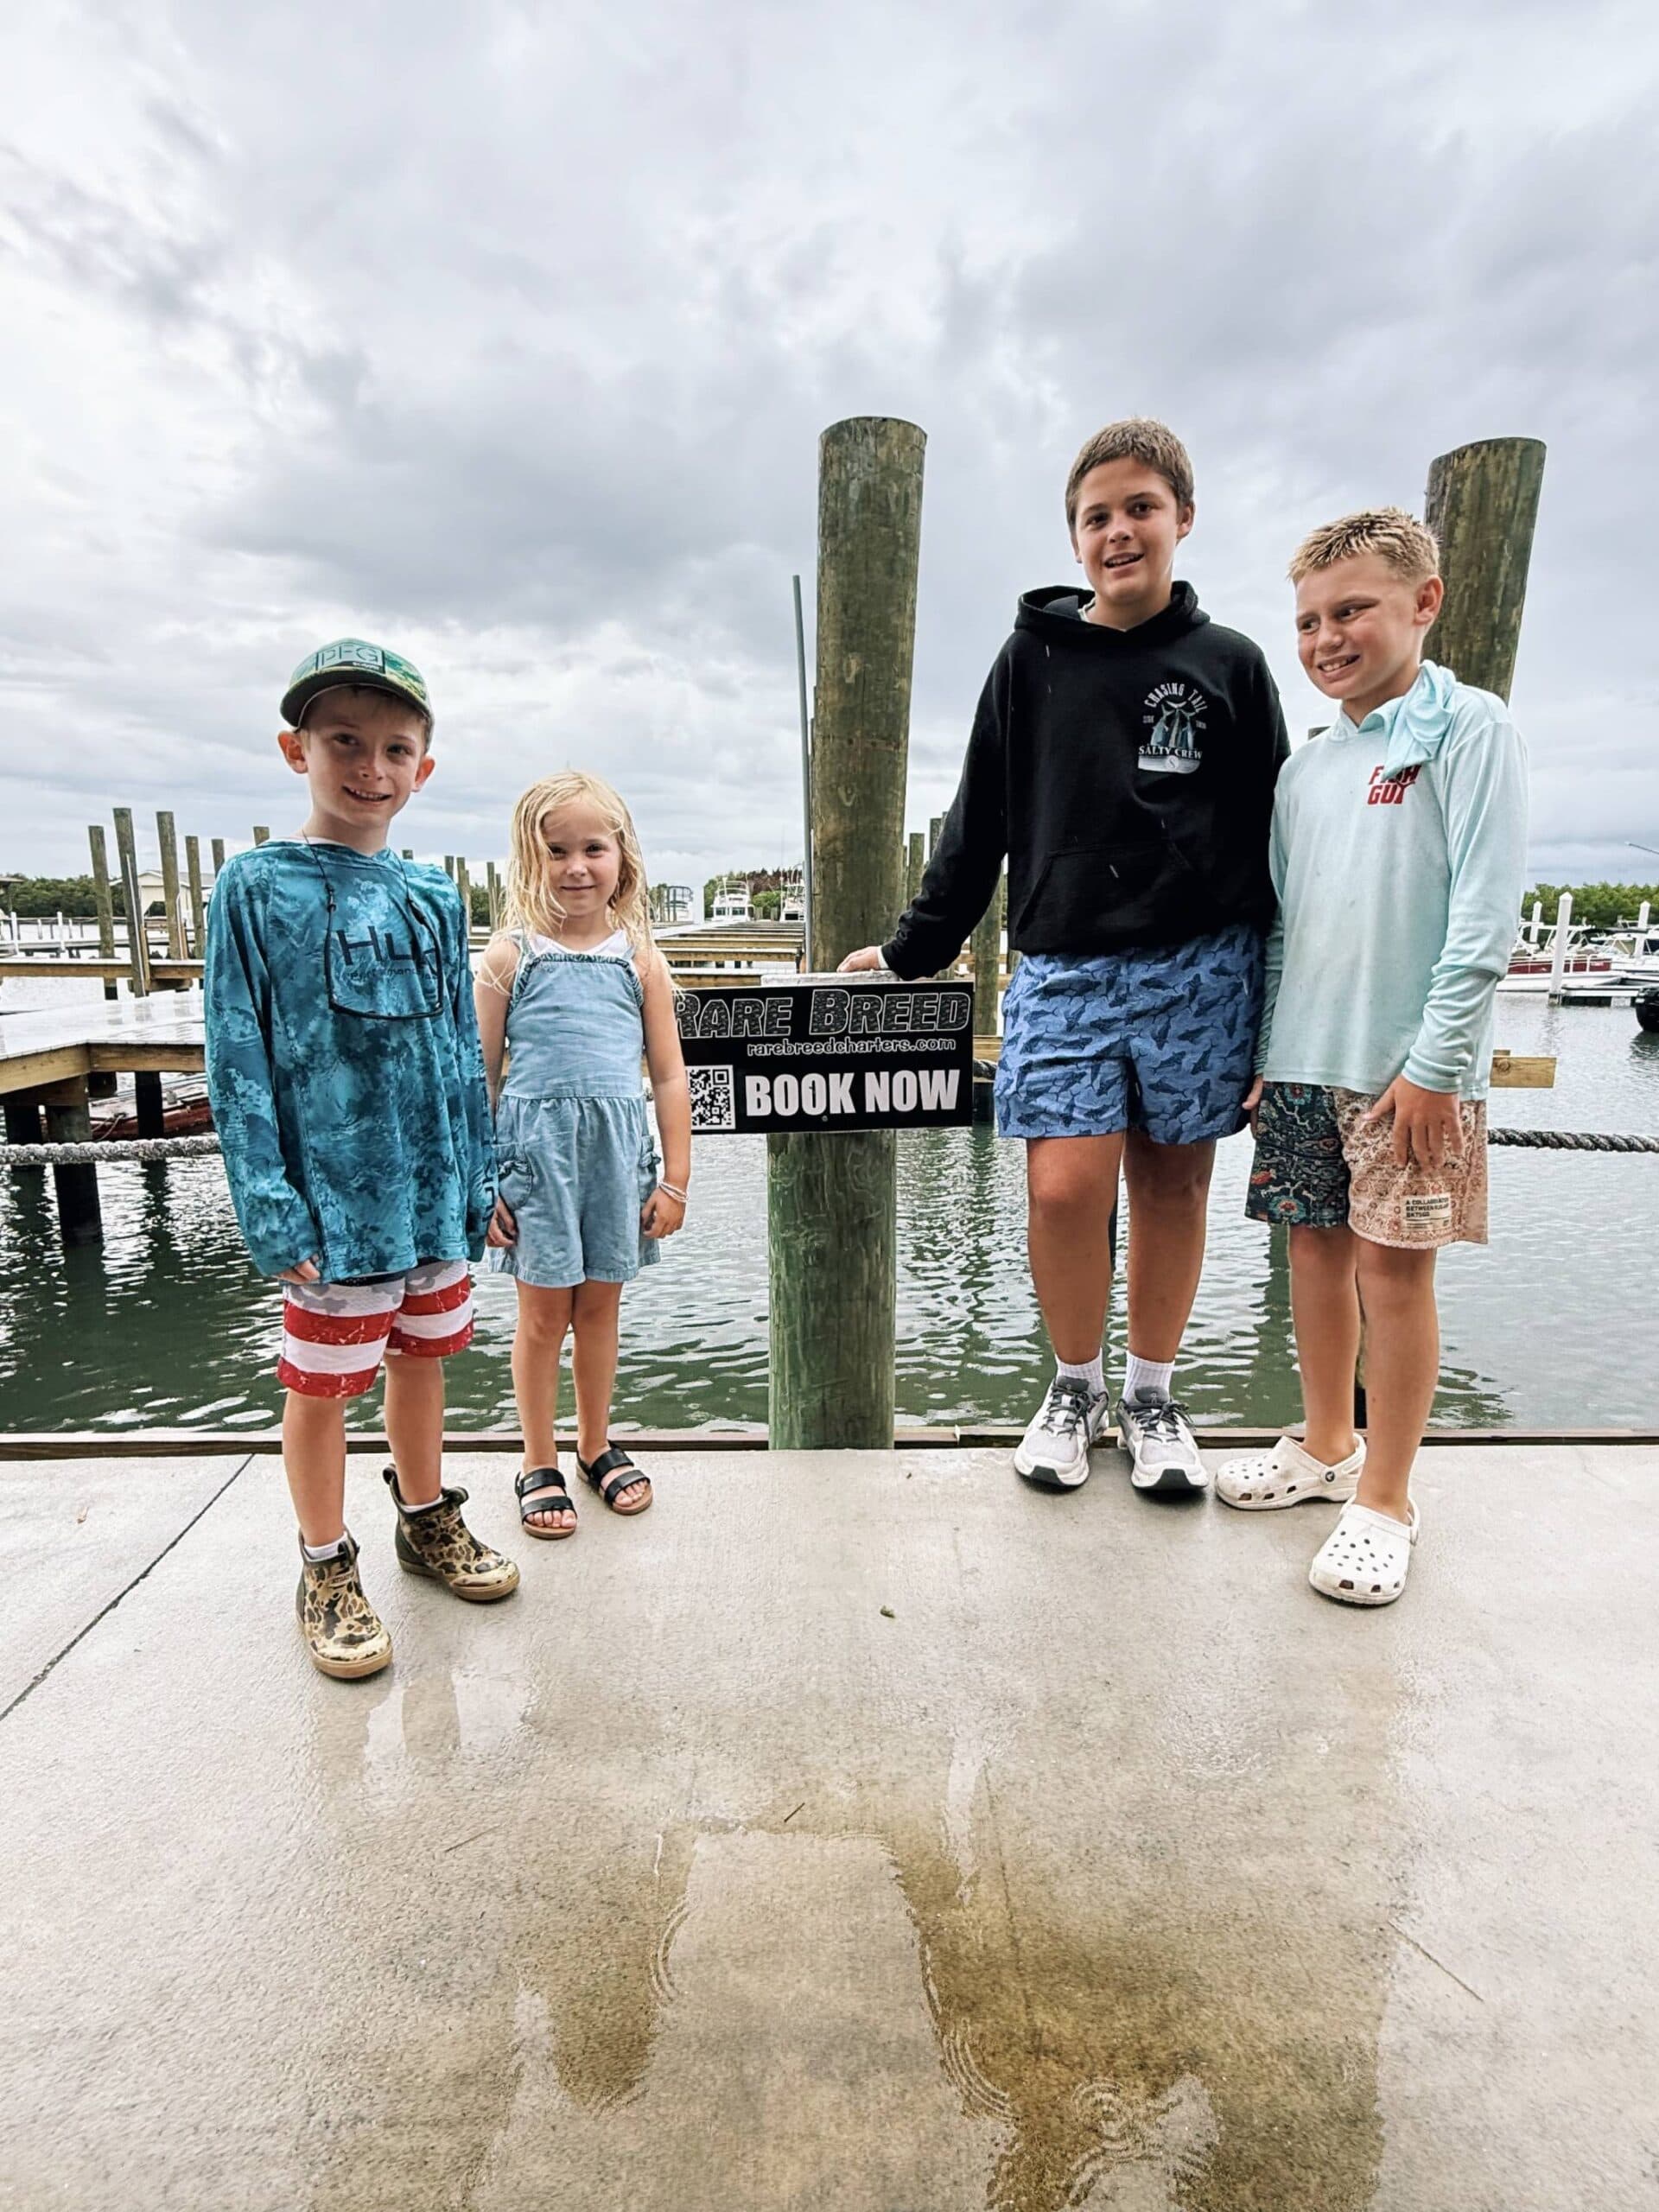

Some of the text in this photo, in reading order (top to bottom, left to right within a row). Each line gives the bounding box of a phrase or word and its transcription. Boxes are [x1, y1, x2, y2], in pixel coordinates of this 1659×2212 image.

[1144, 683, 1208, 713] CHASING TAIL
[1138, 745, 1203, 759] SALTY CREW
[1368, 764, 1422, 785] FH
[1367, 780, 1415, 804] GUY
[674, 994, 793, 1039] RARE
[747, 1036, 957, 1056] rarebreedcharters.com
[745, 1069, 961, 1117] BOOK NOW
